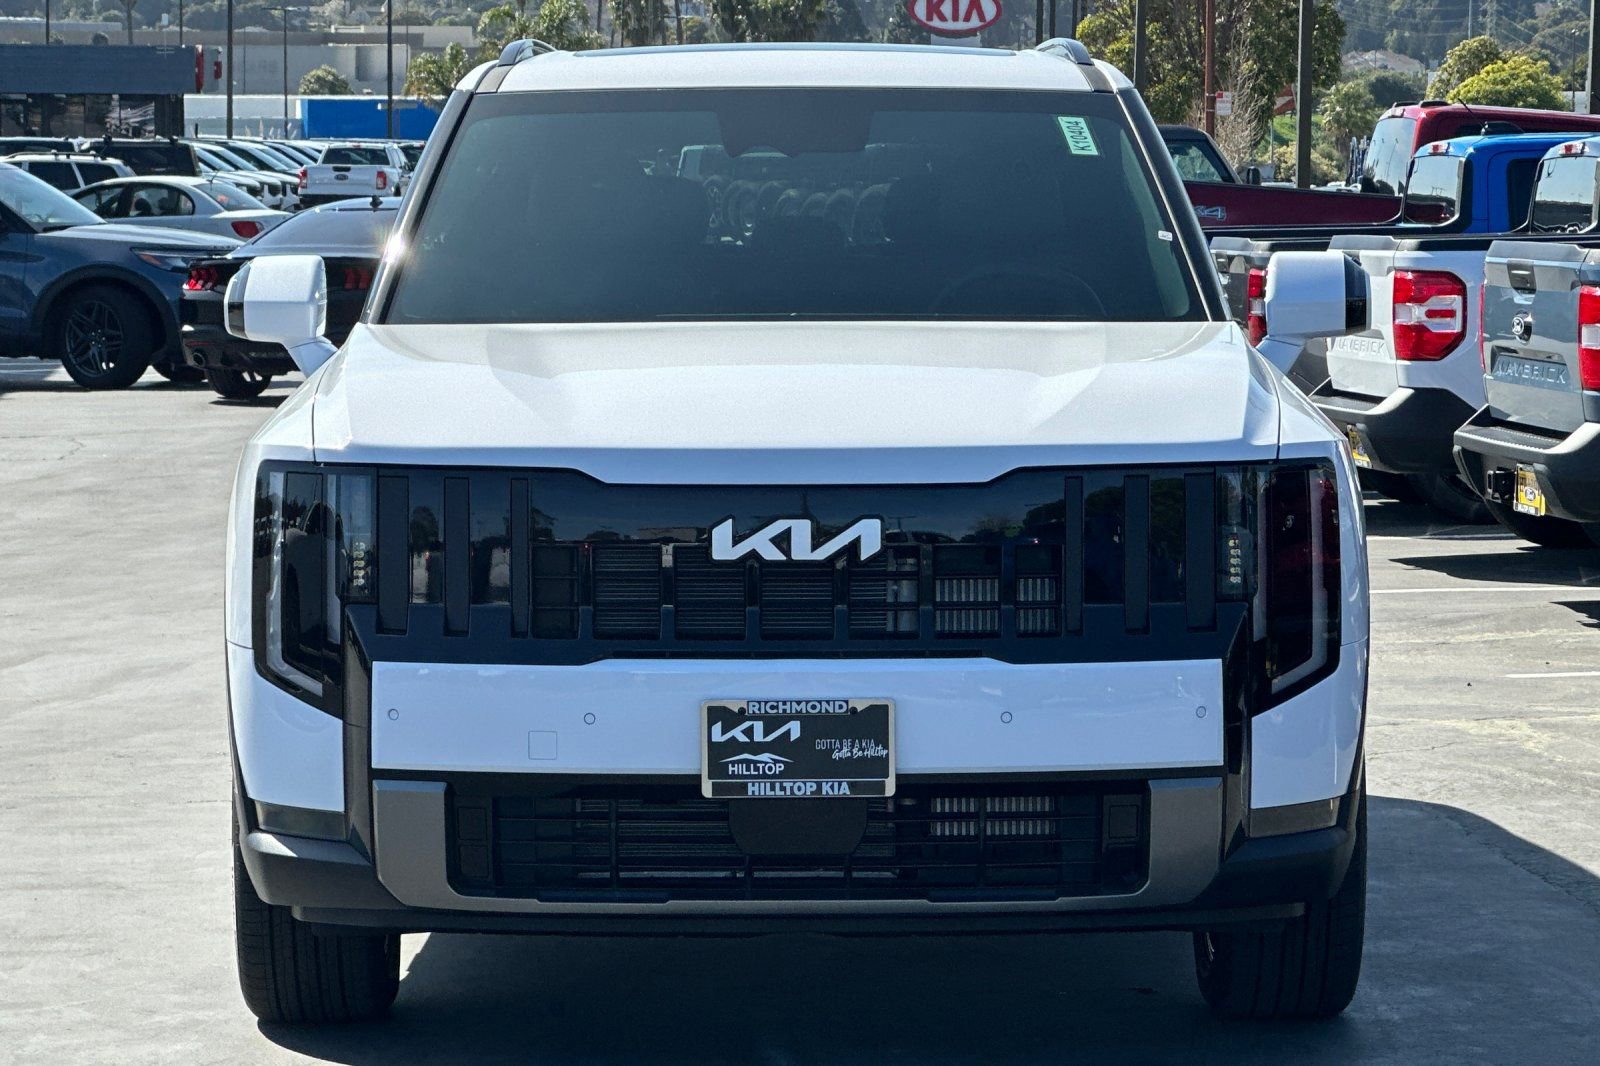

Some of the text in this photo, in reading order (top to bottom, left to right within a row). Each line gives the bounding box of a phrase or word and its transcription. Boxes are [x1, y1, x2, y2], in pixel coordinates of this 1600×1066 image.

[926, 0, 986, 22] KIA
[1064, 120, 1093, 152] K10404
[711, 518, 882, 561] KIA
[747, 701, 848, 714] RICHMOND
[711, 720, 801, 742] KIA
[815, 739, 875, 750] GOTTA BE A KIA
[831, 743, 889, 760] Gotta Be Hilltop
[728, 763, 784, 775] HILLTOP
[747, 782, 851, 796] HILLTOP KIA
